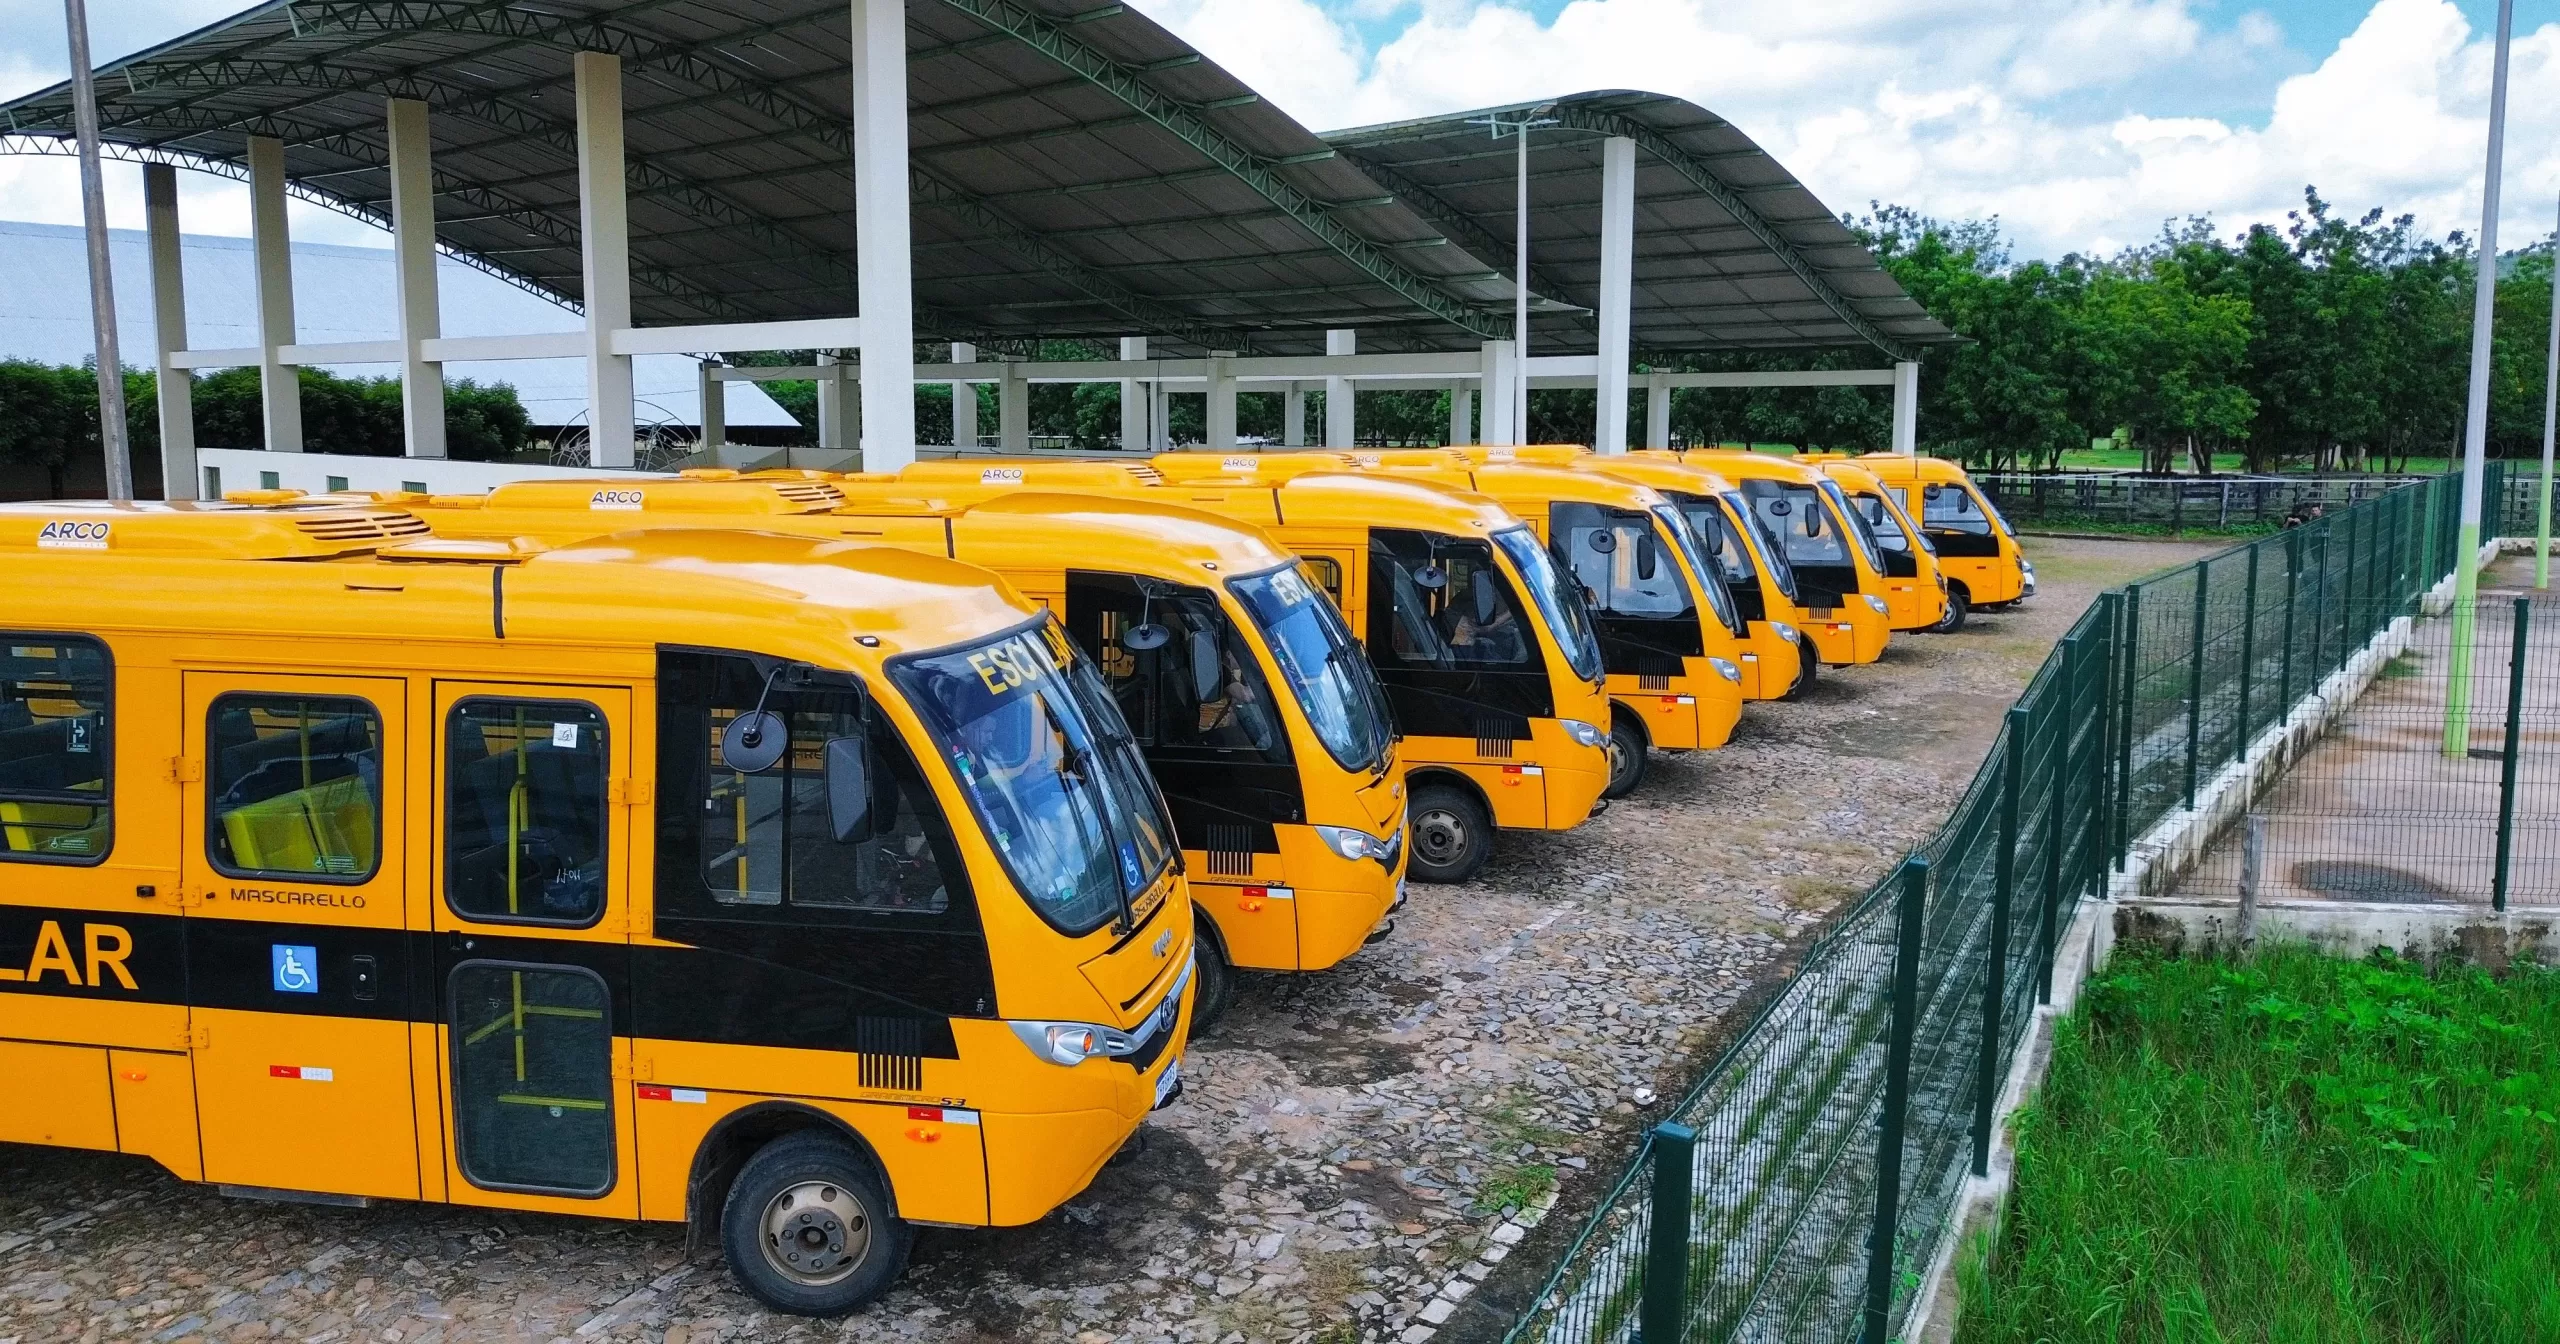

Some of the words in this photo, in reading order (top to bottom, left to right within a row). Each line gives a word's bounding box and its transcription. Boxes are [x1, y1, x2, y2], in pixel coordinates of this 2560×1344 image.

[1223, 458, 1257, 467] ARCO
[1356, 455, 1379, 463] RCO
[981, 469, 1022, 479] ARCO
[591, 491, 642, 503] ARCO
[40, 522, 108, 539] ARCO
[230, 888, 366, 909] MASCARELLO
[941, 1097, 967, 1106] S3
